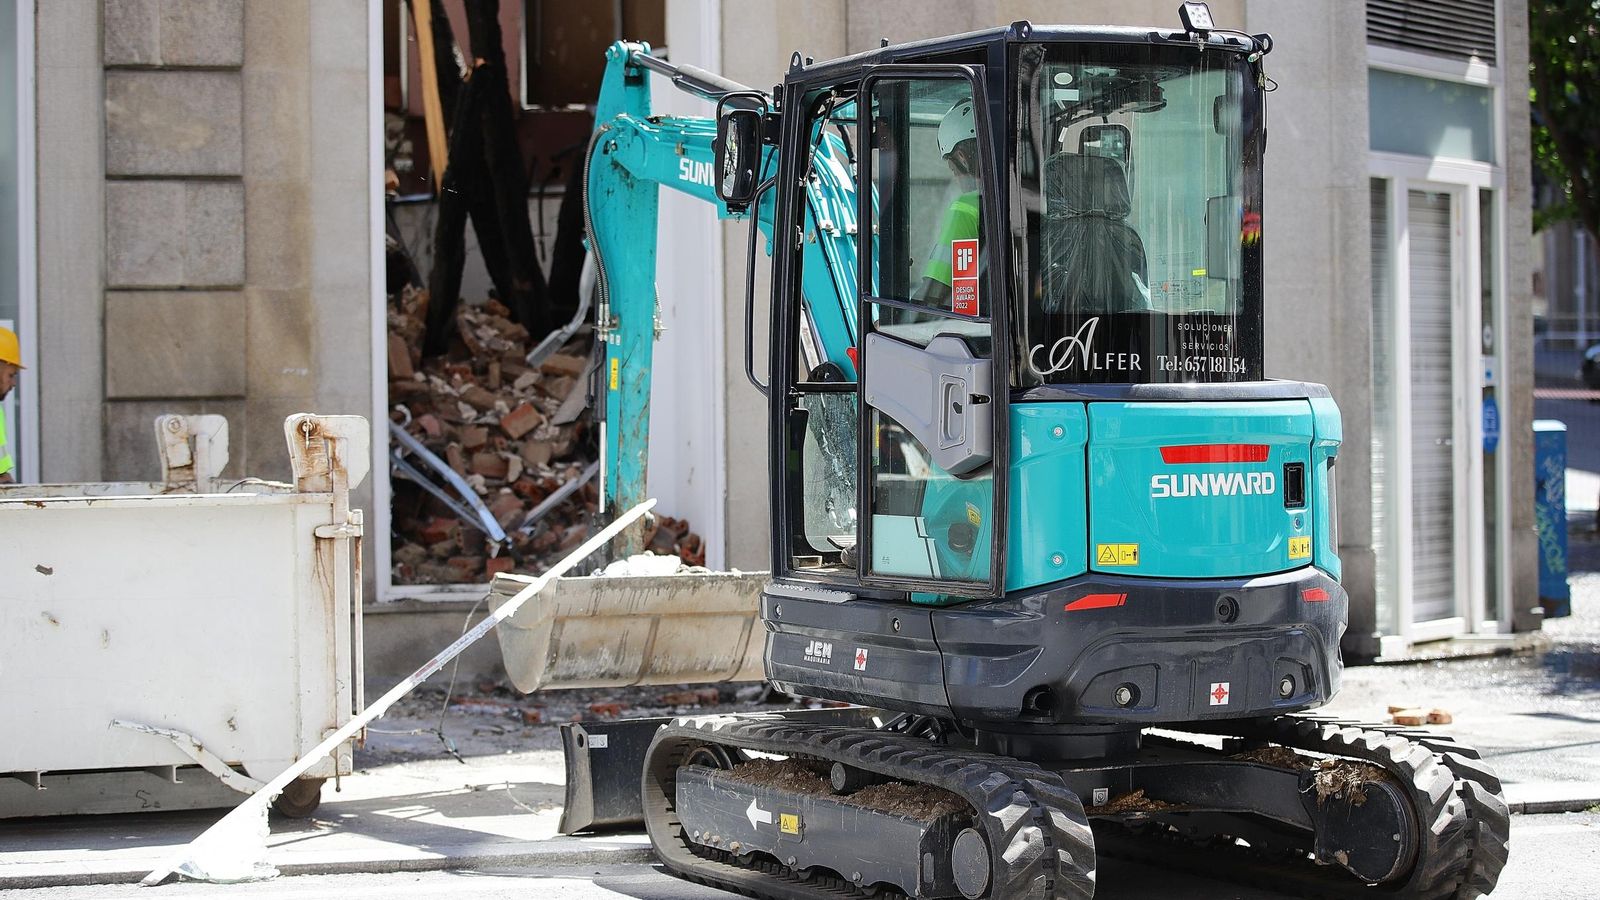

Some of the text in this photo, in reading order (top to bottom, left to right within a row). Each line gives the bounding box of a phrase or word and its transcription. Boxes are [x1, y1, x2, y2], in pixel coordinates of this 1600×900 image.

[956, 286, 975, 294] DESIGN
[1177, 323, 1233, 333] SOLUCIONES
[1182, 342, 1229, 351] SERVICIOS
[1156, 355, 1182, 371] Tel:
[1151, 472, 1276, 498] SUNWARD
